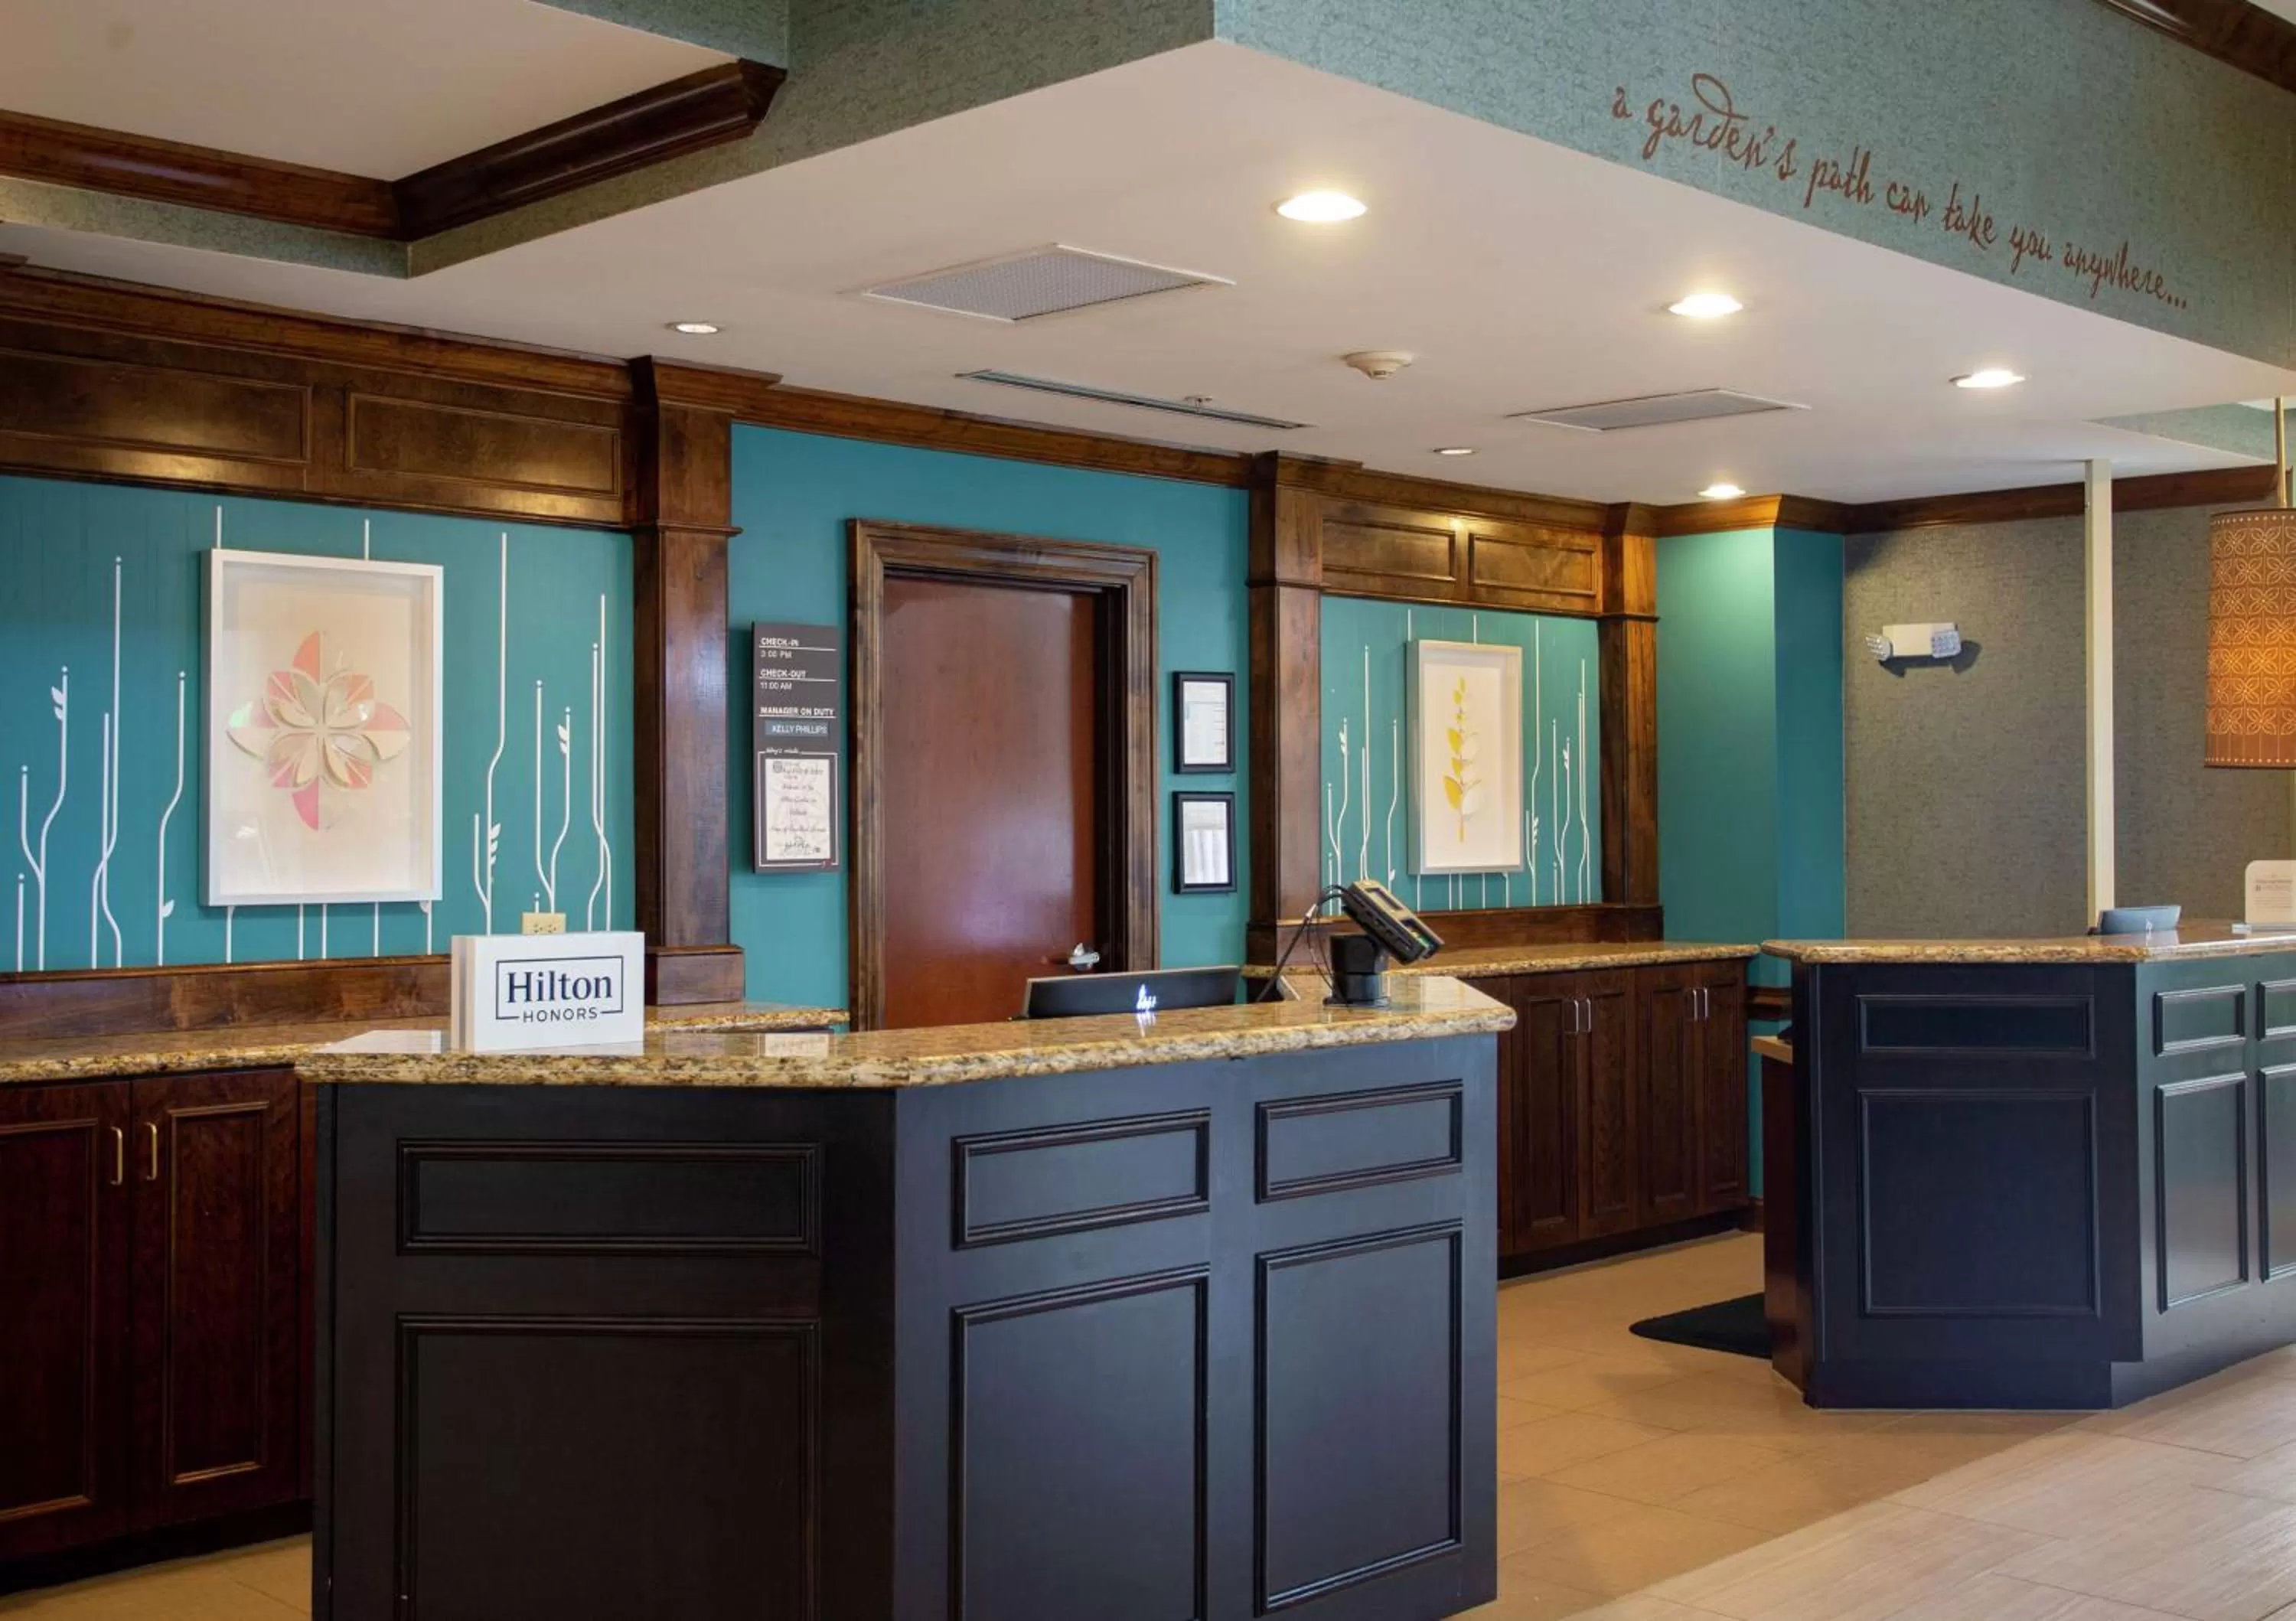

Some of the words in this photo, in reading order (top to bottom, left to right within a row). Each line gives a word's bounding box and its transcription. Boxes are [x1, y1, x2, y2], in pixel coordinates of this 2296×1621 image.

[1612, 86, 1633, 119] a
[1642, 73, 1798, 181] garden's
[1803, 145, 1875, 209] path
[1886, 181, 1931, 223] can
[1942, 180, 1998, 251] take
[2009, 226, 2053, 275] you
[2063, 241, 2187, 309] anywhere...
[760, 667, 807, 679] CHECK-OUT
[760, 706, 798, 715] MANAGER
[800, 707, 812, 716] ON
[814, 707, 834, 716] DUTY
[506, 970, 613, 1003] Hilton
[523, 1006, 598, 1023] HONORS
